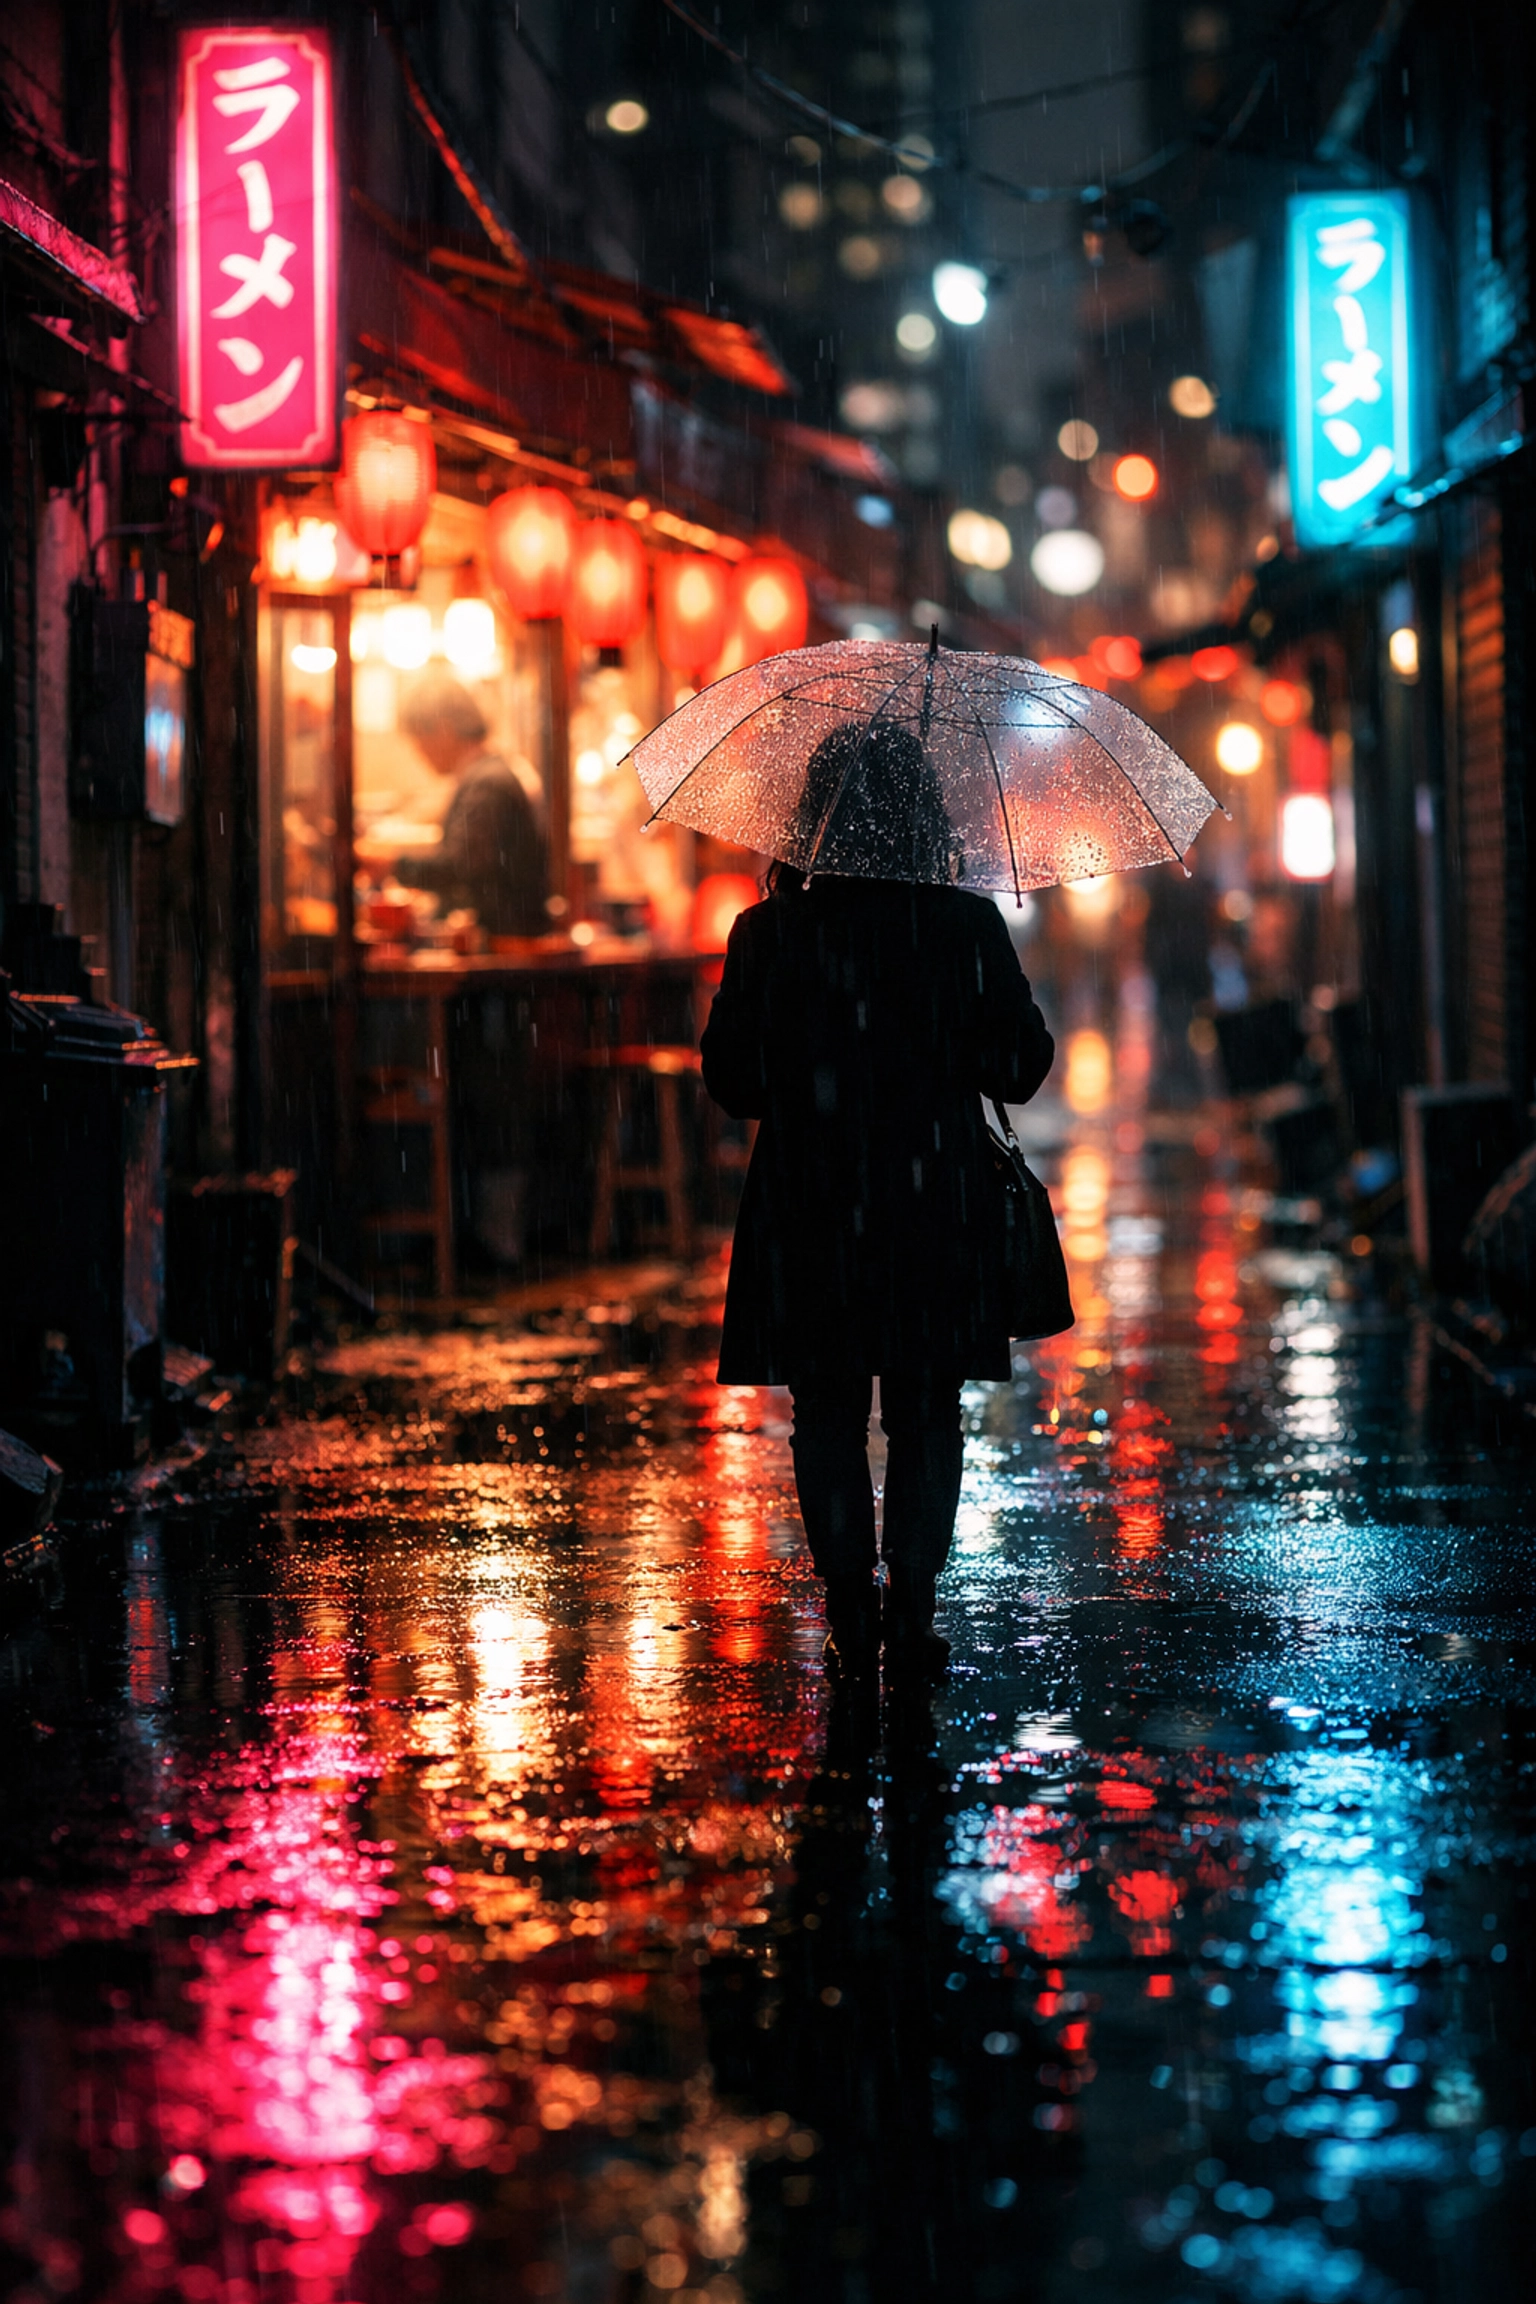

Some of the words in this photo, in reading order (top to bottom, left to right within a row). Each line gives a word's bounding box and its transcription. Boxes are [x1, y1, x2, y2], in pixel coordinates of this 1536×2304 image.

[212, 57, 303, 432] ラーメン
[1316, 218, 1394, 511] ラーメン
